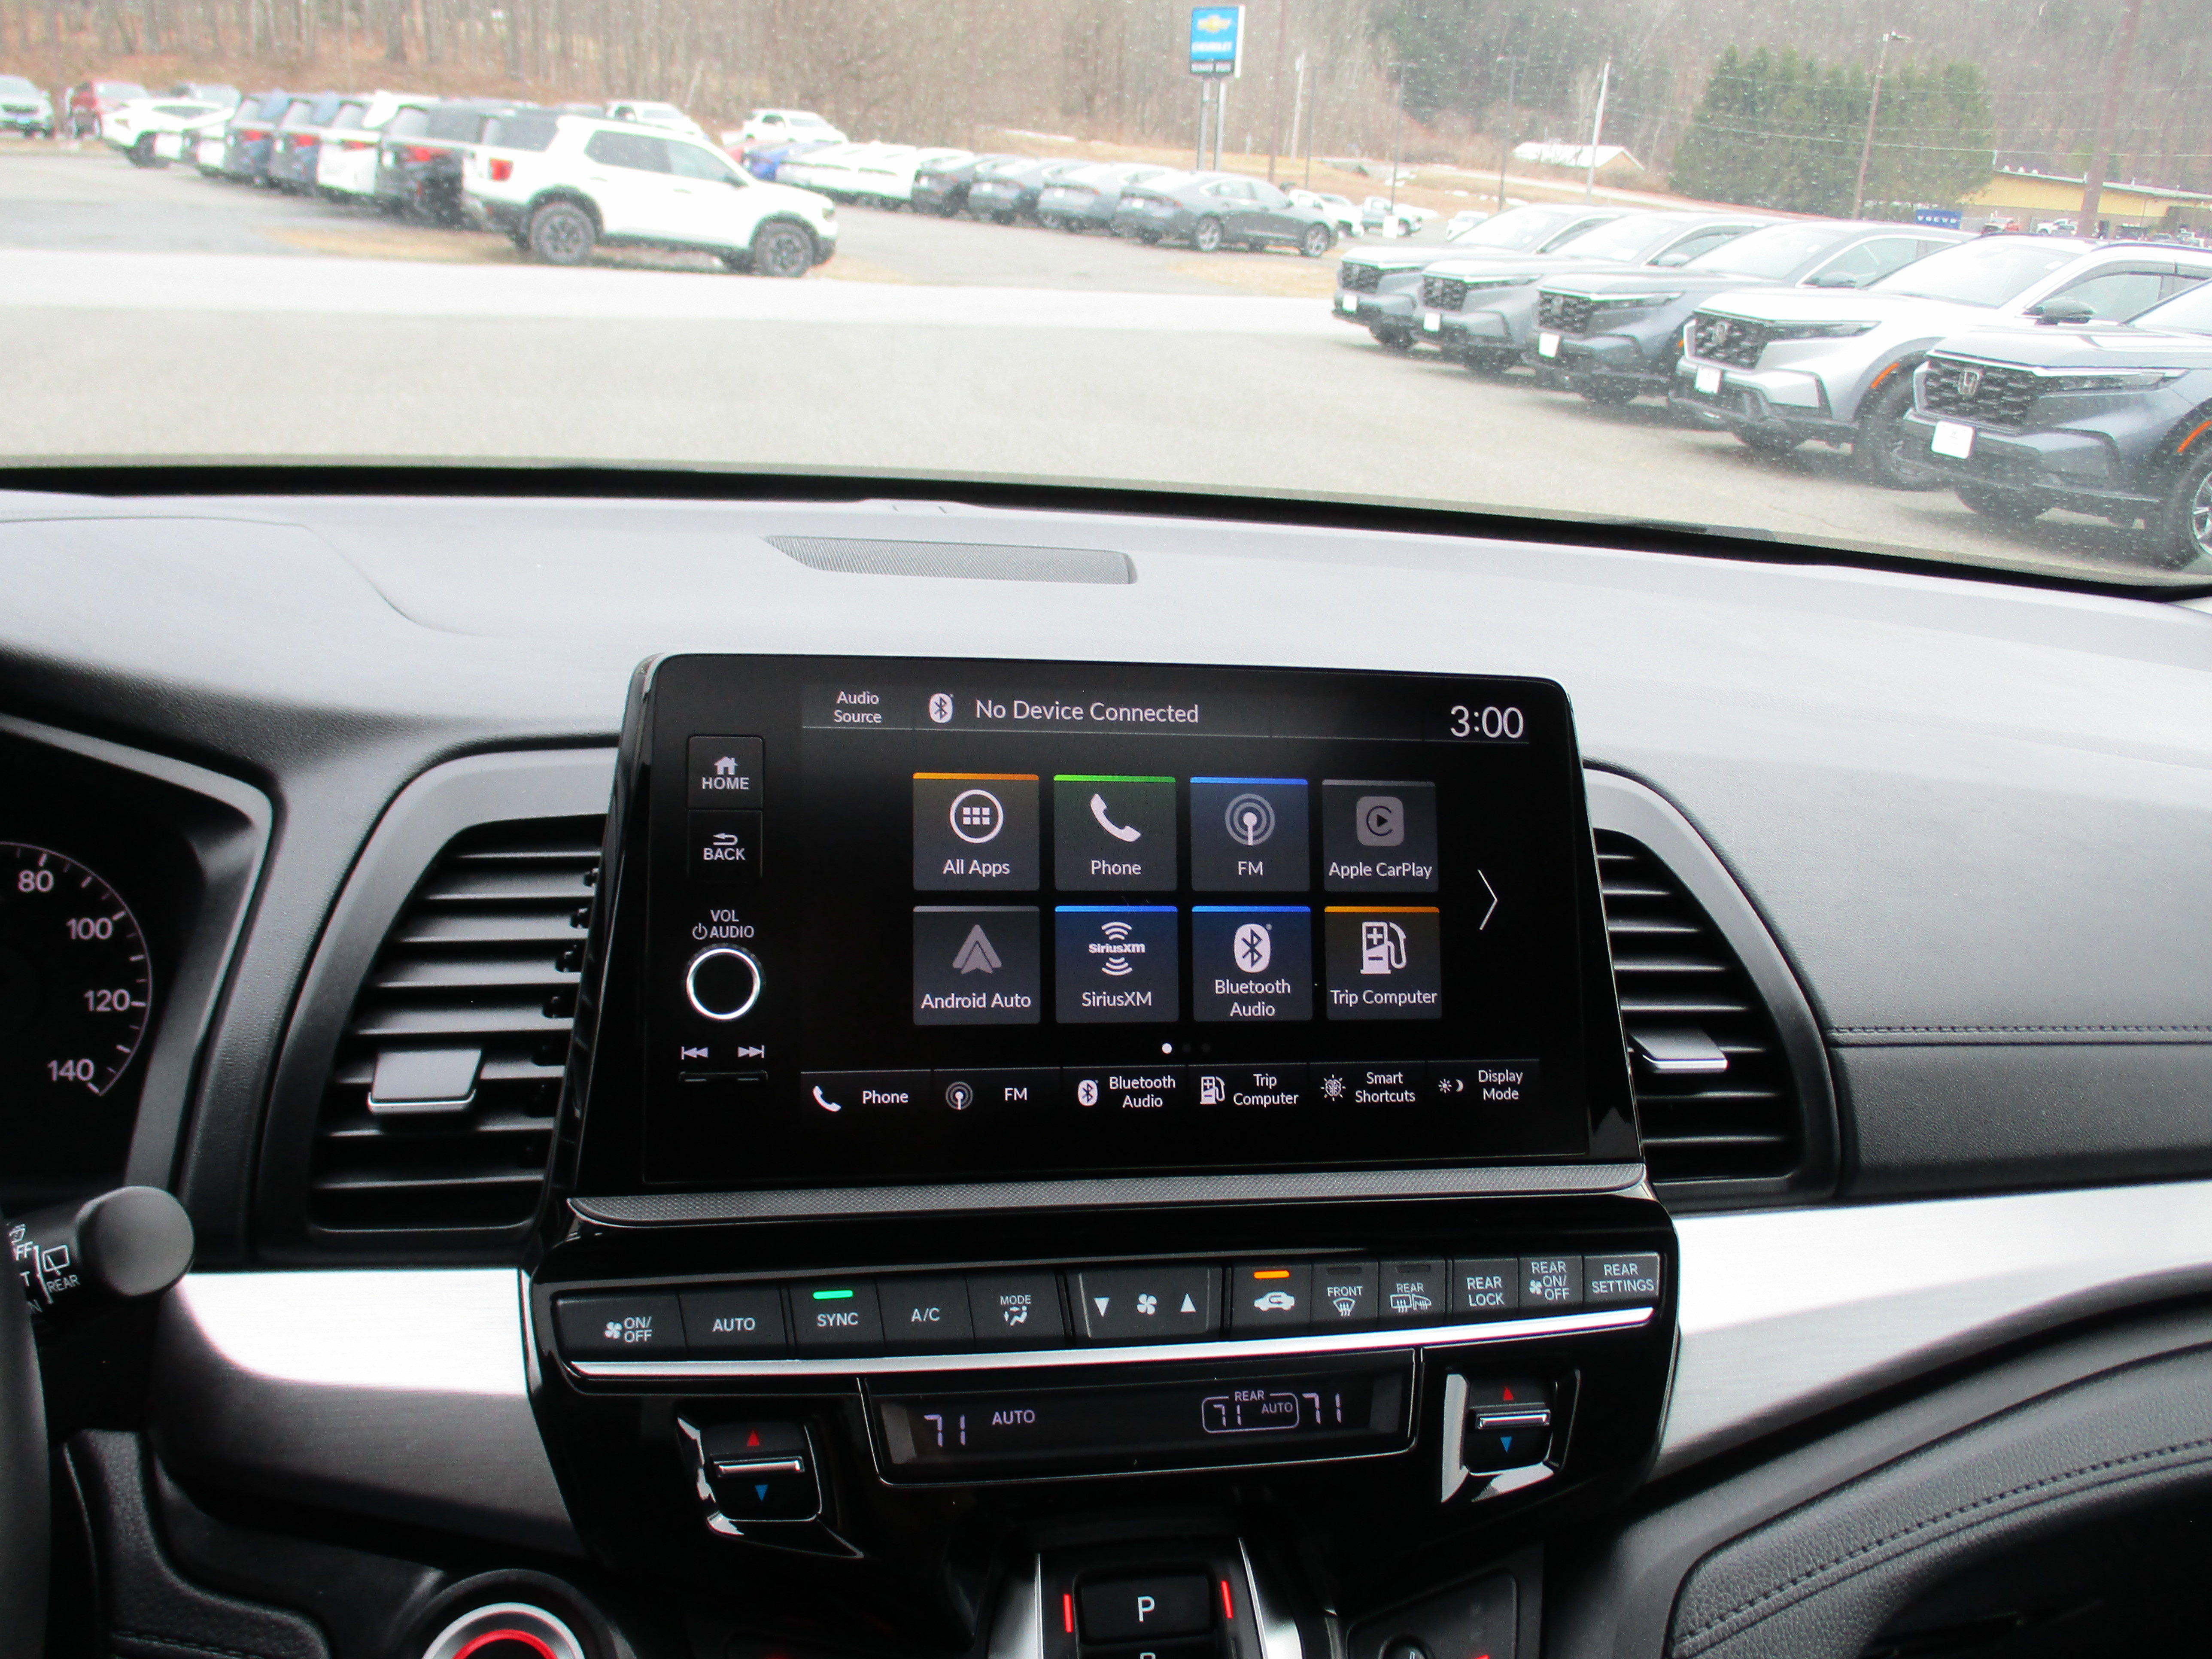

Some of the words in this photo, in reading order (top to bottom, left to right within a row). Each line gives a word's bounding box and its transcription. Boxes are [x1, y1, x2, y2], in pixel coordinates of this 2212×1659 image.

[836, 691, 880, 705] Audio
[834, 709, 882, 723] Source
[976, 699, 1006, 718] No
[1014, 700, 1084, 720] Device
[1090, 702, 1198, 723] Connected
[1450, 705, 1524, 738] 3:00
[702, 777, 749, 790] HOME
[703, 848, 745, 860] BACK
[942, 859, 964, 874] All
[968, 859, 1010, 877] Apps
[1091, 860, 1141, 875] Phone
[1238, 861, 1263, 875] FM
[1329, 861, 1372, 879] Apple
[1376, 862, 1432, 879] CarPlay
[18, 870, 54, 892] 80
[710, 909, 739, 922] VOL
[67, 917, 113, 940] 100
[709, 925, 754, 939] AUDIO
[1215, 978, 1291, 994] Bluetooth
[84, 989, 131, 1012] 120
[921, 992, 986, 1009] Android
[991, 993, 1031, 1008] Auto
[1082, 991, 1152, 1007] SiriusXM
[1330, 989, 1358, 1007] Trip
[1362, 990, 1437, 1007] Computer
[1230, 1001, 1275, 1017] Audio
[48, 1058, 94, 1081] 140
[1478, 1069, 1523, 1085] Display
[1109, 1075, 1176, 1090] Bluetooth
[1253, 1073, 1277, 1089] Trip
[1367, 1072, 1403, 1085] Smart
[863, 1090, 908, 1104] Phone
[1005, 1087, 1027, 1101] FM
[1122, 1094, 1163, 1108] Audio
[1233, 1092, 1299, 1108] Computer
[1355, 1089, 1416, 1103] Shortcuts
[1483, 1087, 1519, 1100] Mode
[13, 1241, 33, 1261] FF
[1531, 1261, 1566, 1274] REAR
[1604, 1263, 1638, 1276] REAR
[46, 1274, 81, 1293] REAR
[1396, 1282, 1424, 1294] REAR
[1467, 1276, 1502, 1290] REAR
[1542, 1275, 1568, 1289] ON/
[1592, 1278, 1654, 1294] SETTINGS
[1327, 1285, 1363, 1298] FRONT
[1544, 1286, 1569, 1300] OFF
[1000, 1294, 1031, 1305] MODE
[1468, 1292, 1504, 1307] LOCK
[817, 1312, 859, 1327] SYNC
[911, 1307, 940, 1322] A/C
[624, 1316, 652, 1331] ON/
[713, 1317, 755, 1332] AUTO
[624, 1329, 652, 1343] OFF
[1234, 1390, 1264, 1401] REAR
[1211, 1404, 1243, 1428] 71
[1261, 1402, 1293, 1414] AUTO
[1302, 1392, 1342, 1424] 71
[924, 1414, 966, 1447] 71
[992, 1409, 1035, 1425] AUTO
[1137, 1596, 1155, 1623] P
